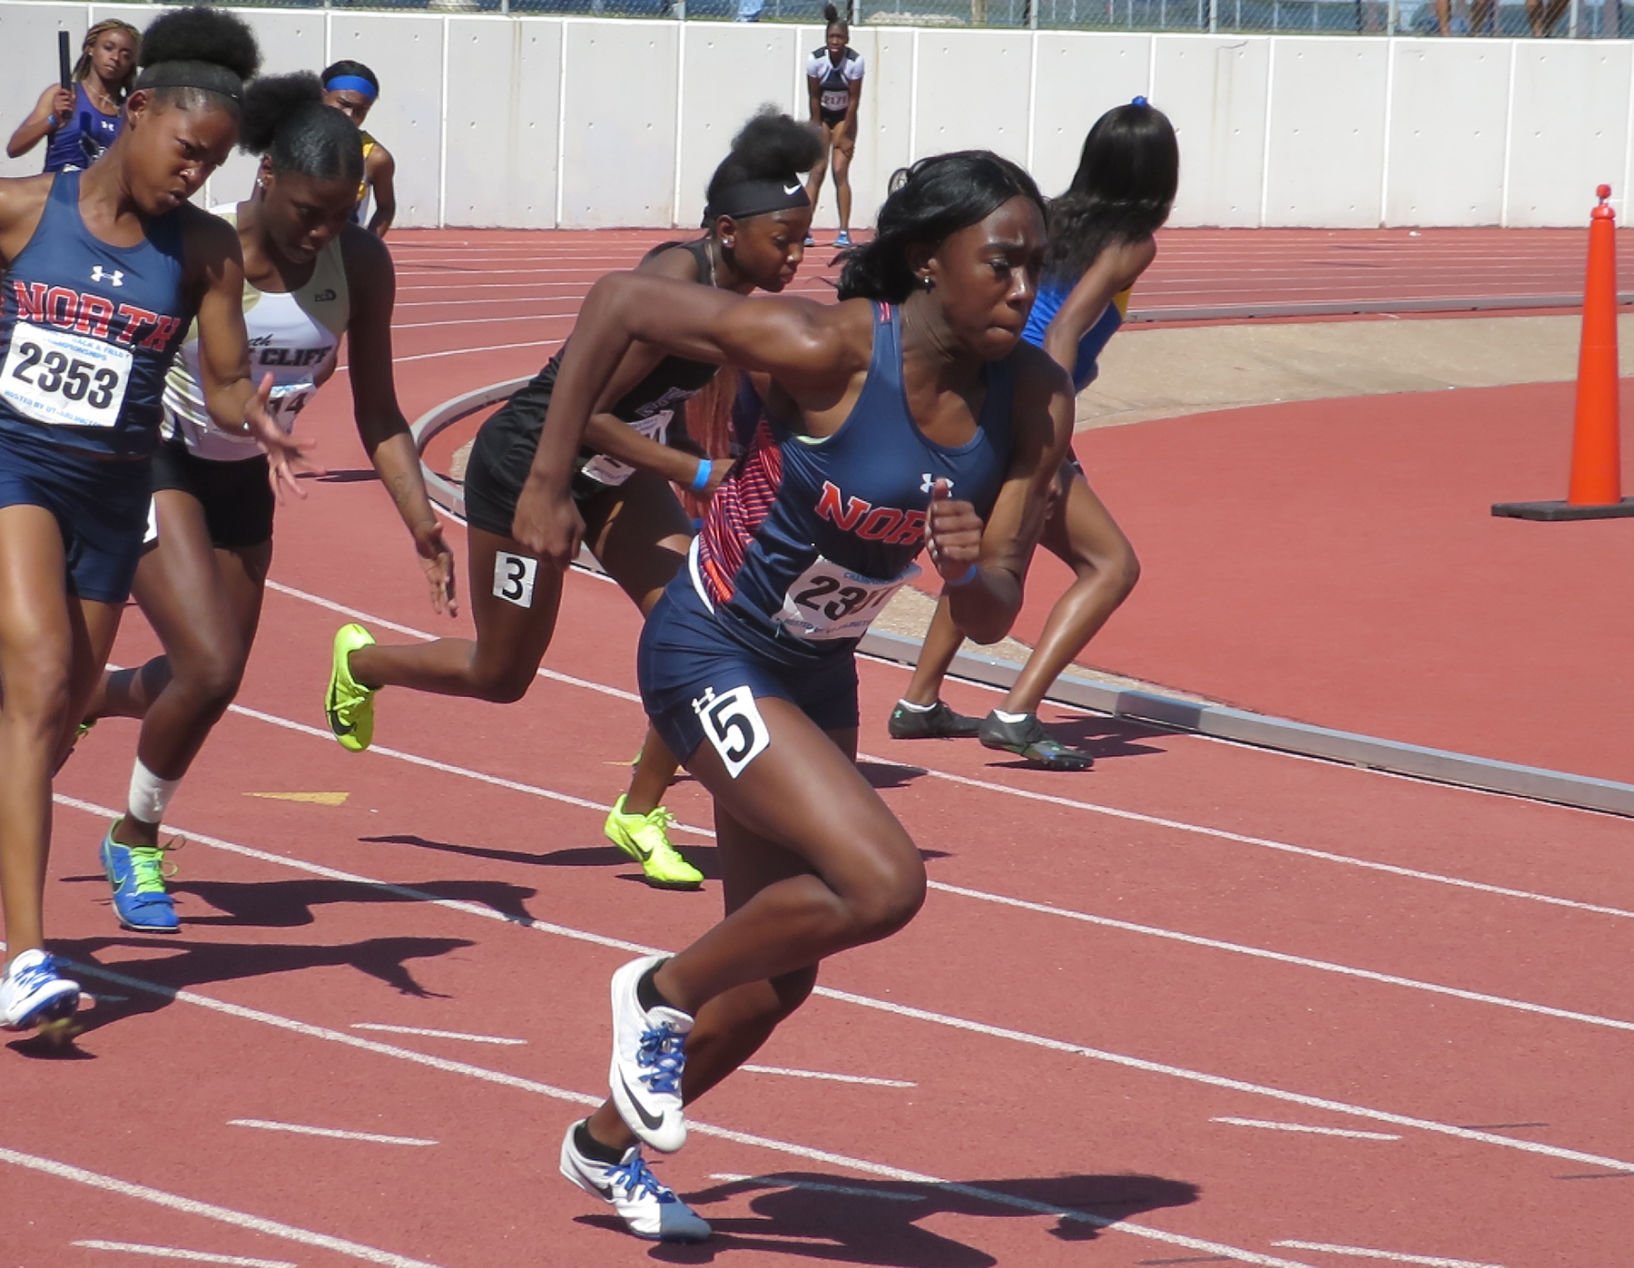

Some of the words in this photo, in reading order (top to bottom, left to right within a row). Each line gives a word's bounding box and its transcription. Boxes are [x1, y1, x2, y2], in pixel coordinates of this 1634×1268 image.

[13, 280, 181, 352] NORTH
[12, 342, 118, 410] 2353
[259, 345, 332, 367] CLIFF
[815, 479, 927, 546] NOR
[502, 557, 526, 601] 3
[708, 695, 755, 763] 5
